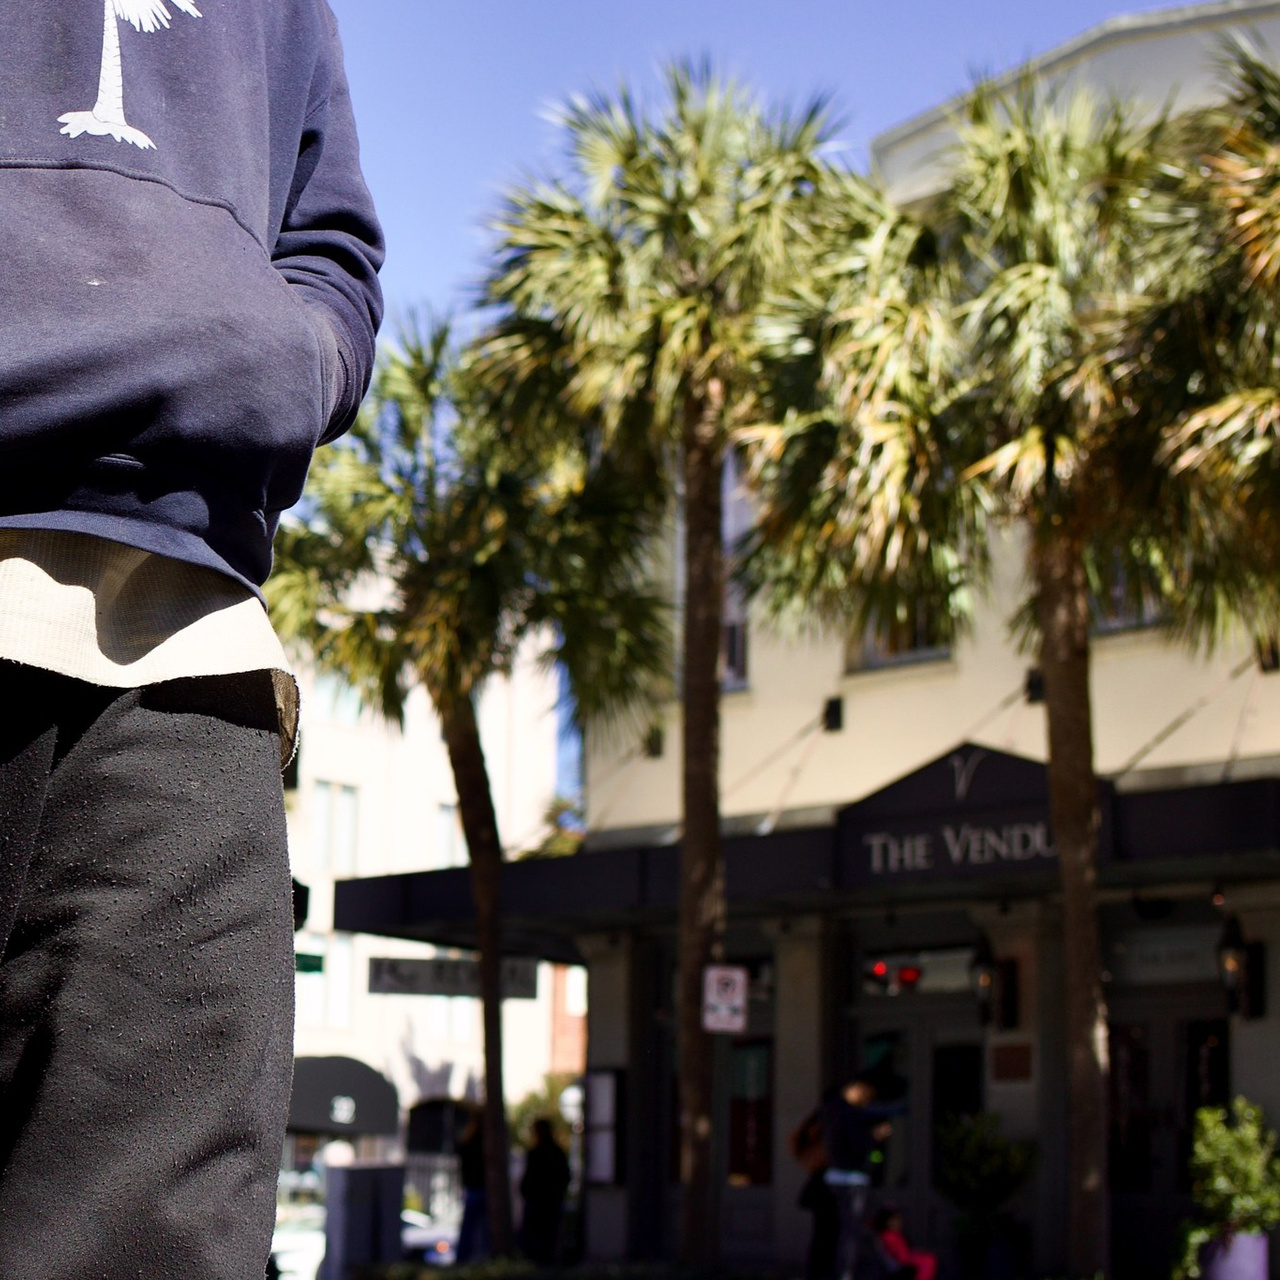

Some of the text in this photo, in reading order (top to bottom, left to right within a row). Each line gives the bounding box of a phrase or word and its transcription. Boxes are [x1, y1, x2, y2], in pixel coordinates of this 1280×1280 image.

[949, 751, 986, 801] V
[863, 822, 1058, 873] THE VENDU
